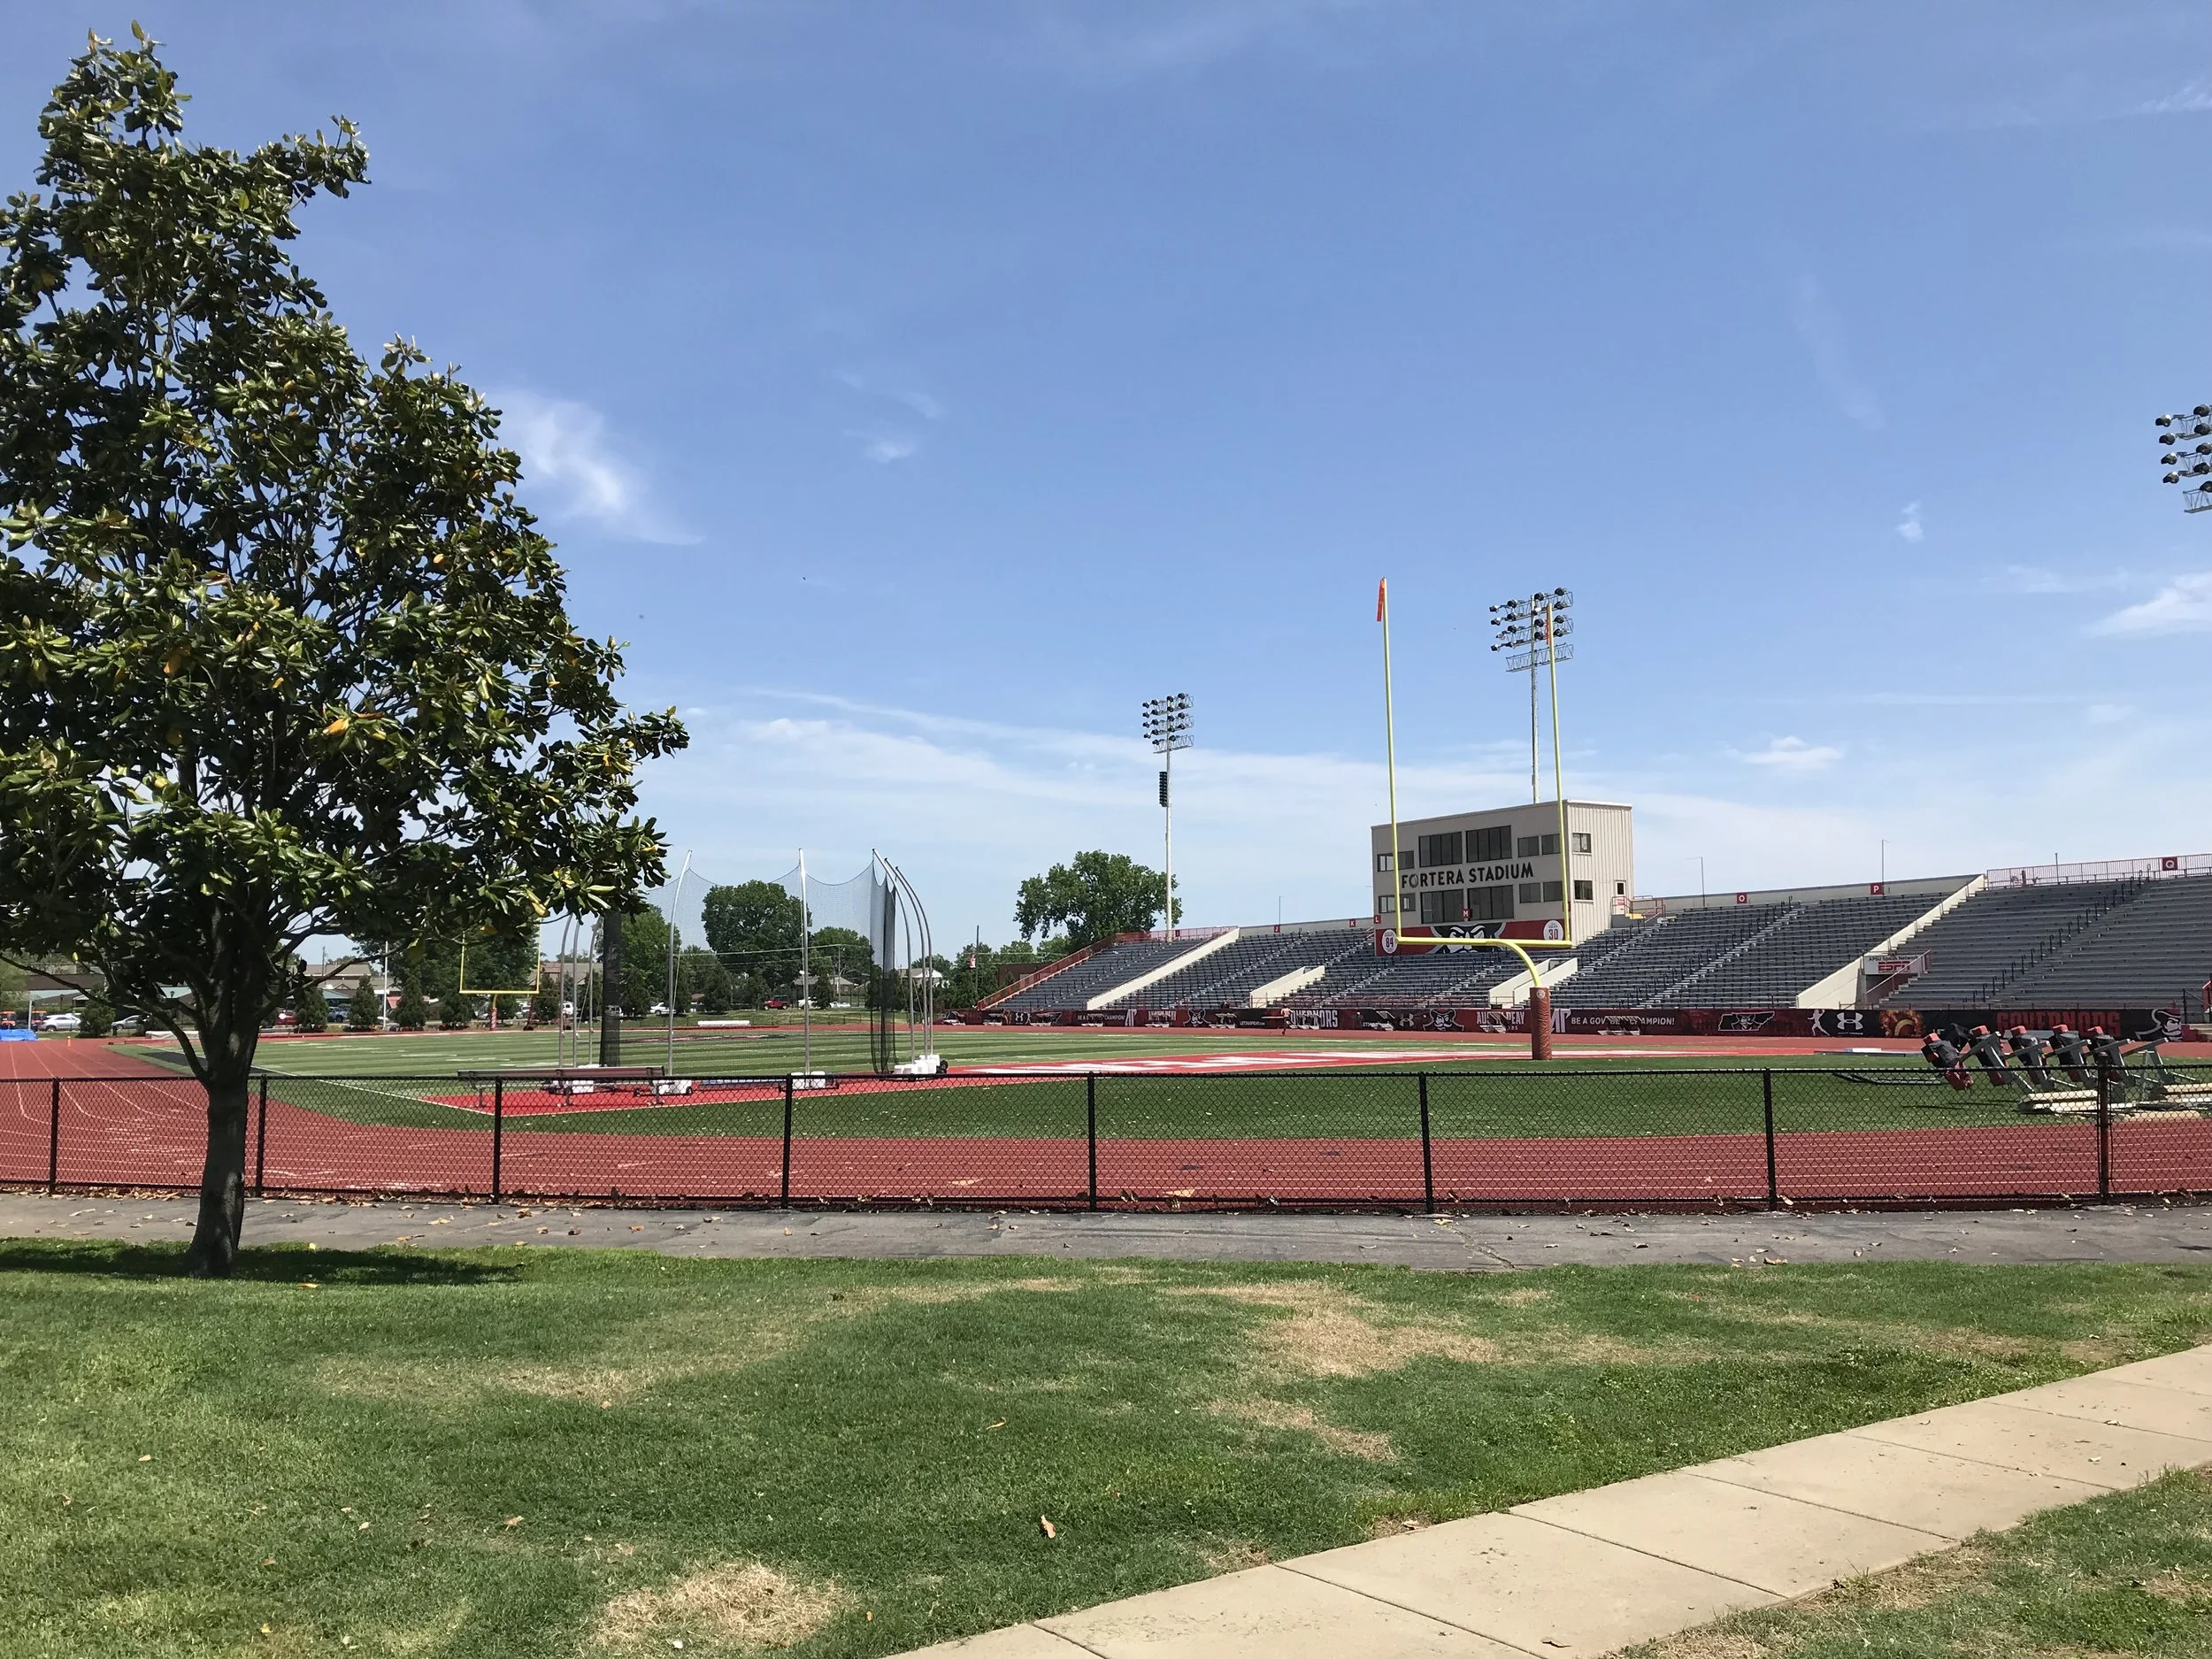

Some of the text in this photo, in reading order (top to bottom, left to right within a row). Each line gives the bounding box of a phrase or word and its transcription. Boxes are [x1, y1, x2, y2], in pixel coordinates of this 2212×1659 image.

[2165, 860, 2175, 869] Q
[1402, 862, 1534, 888] FORTERA STADIUM
[1873, 885, 1879, 894] P
[1548, 929, 1559, 940] 30
[1386, 937, 1394, 948] 84
[1878, 961, 1911, 972] ESPN
